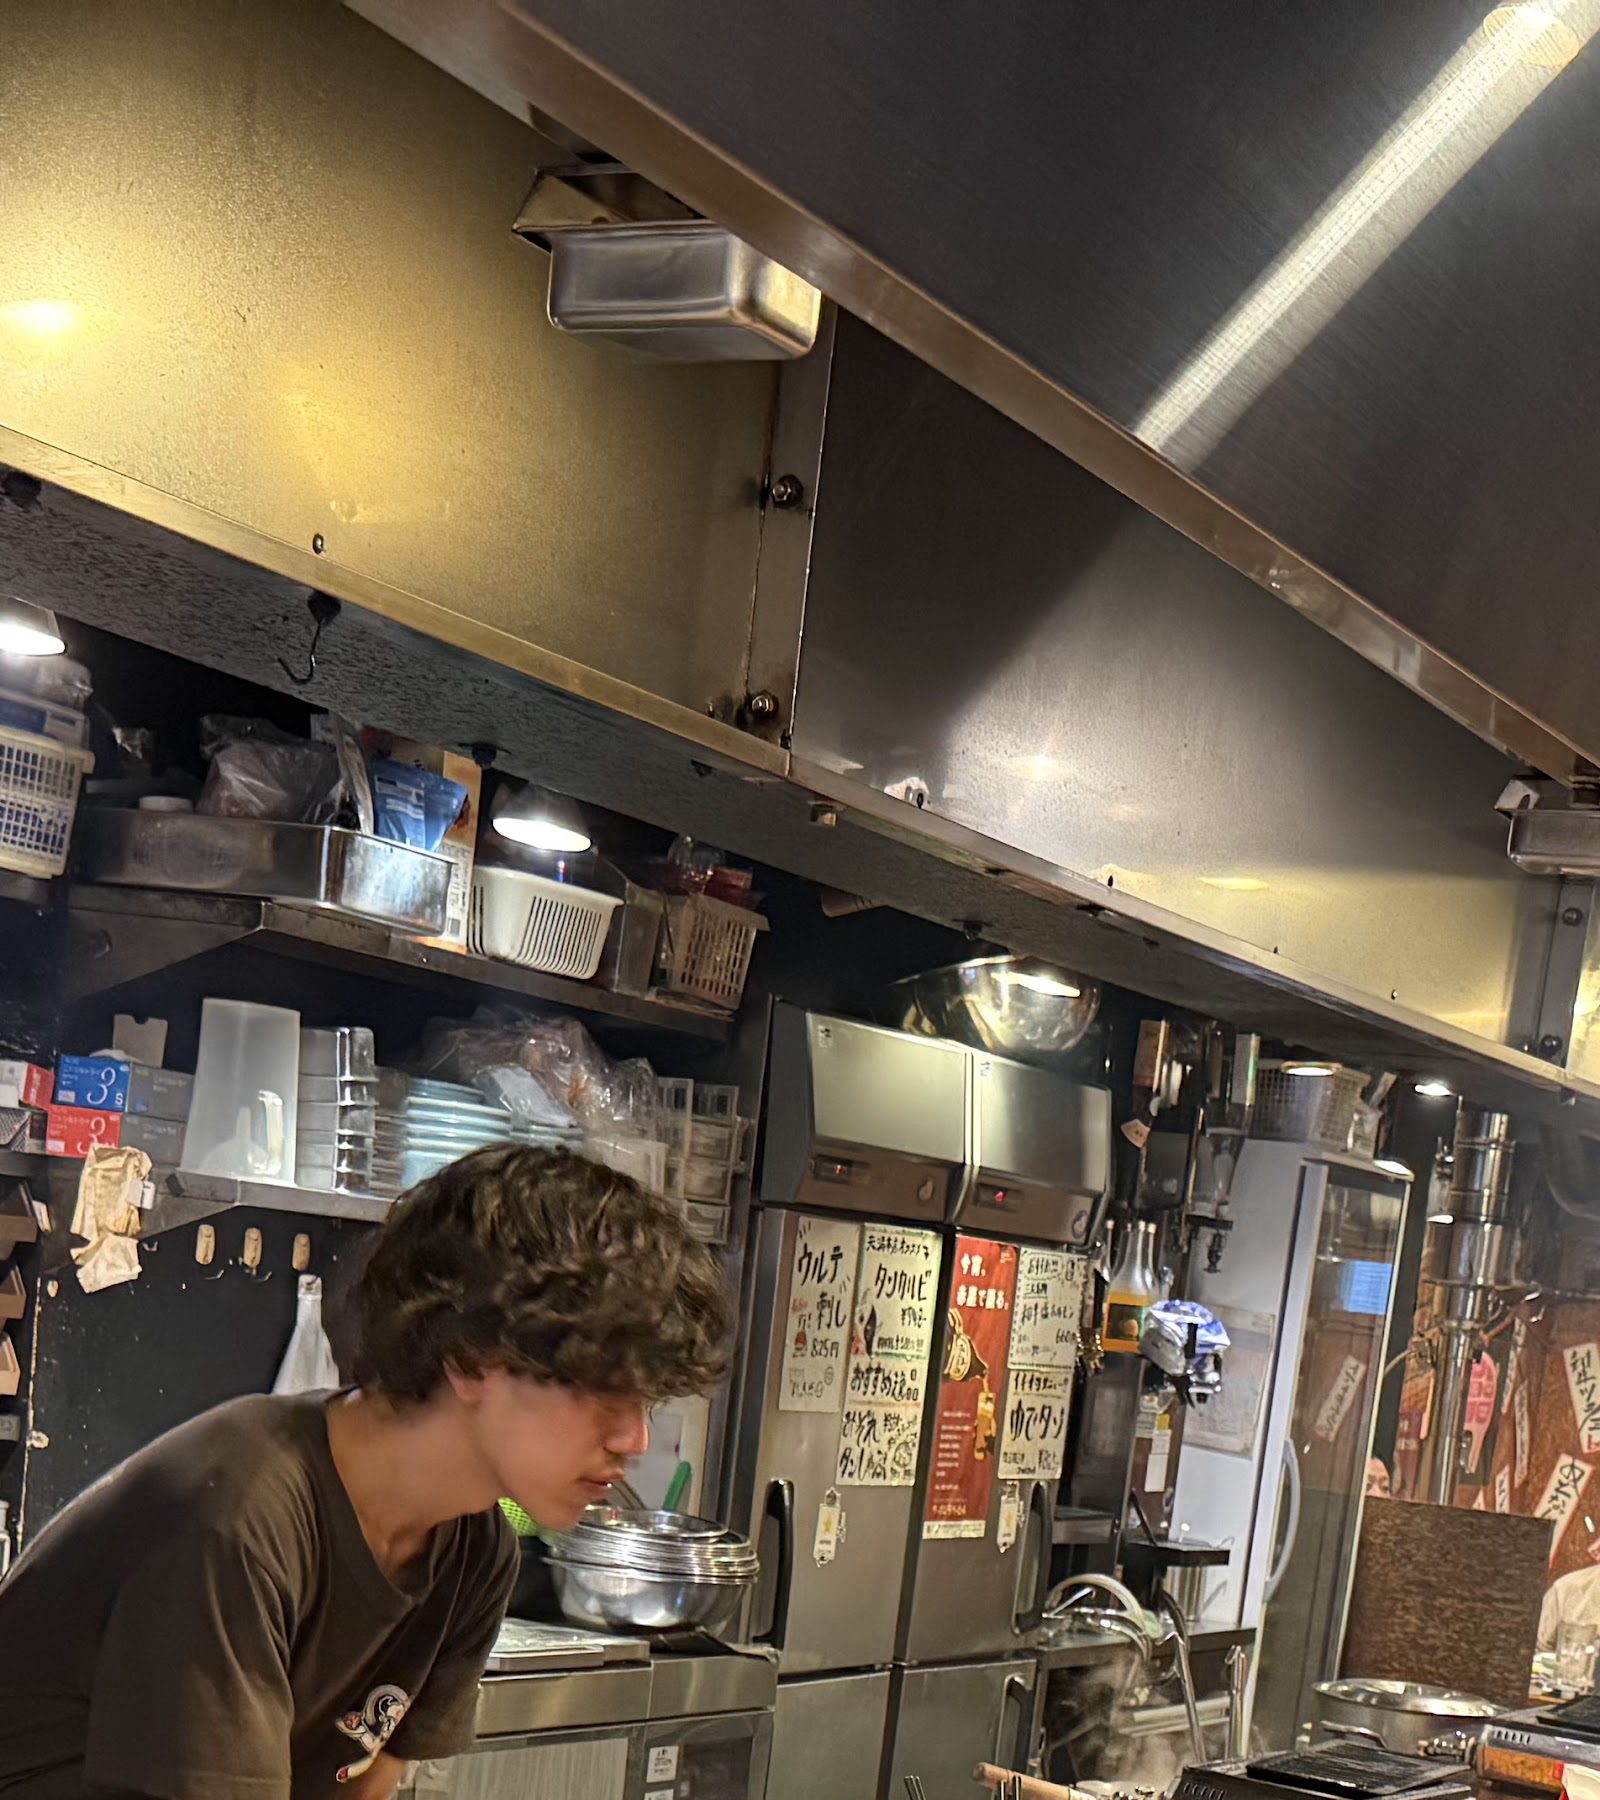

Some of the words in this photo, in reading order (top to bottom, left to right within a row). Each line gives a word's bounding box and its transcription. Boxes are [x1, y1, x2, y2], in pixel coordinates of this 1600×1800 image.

[114, 1092, 123, 1106] S
[797, 1242, 843, 1287] ウルテ
[816, 1291, 847, 1331] 刺し
